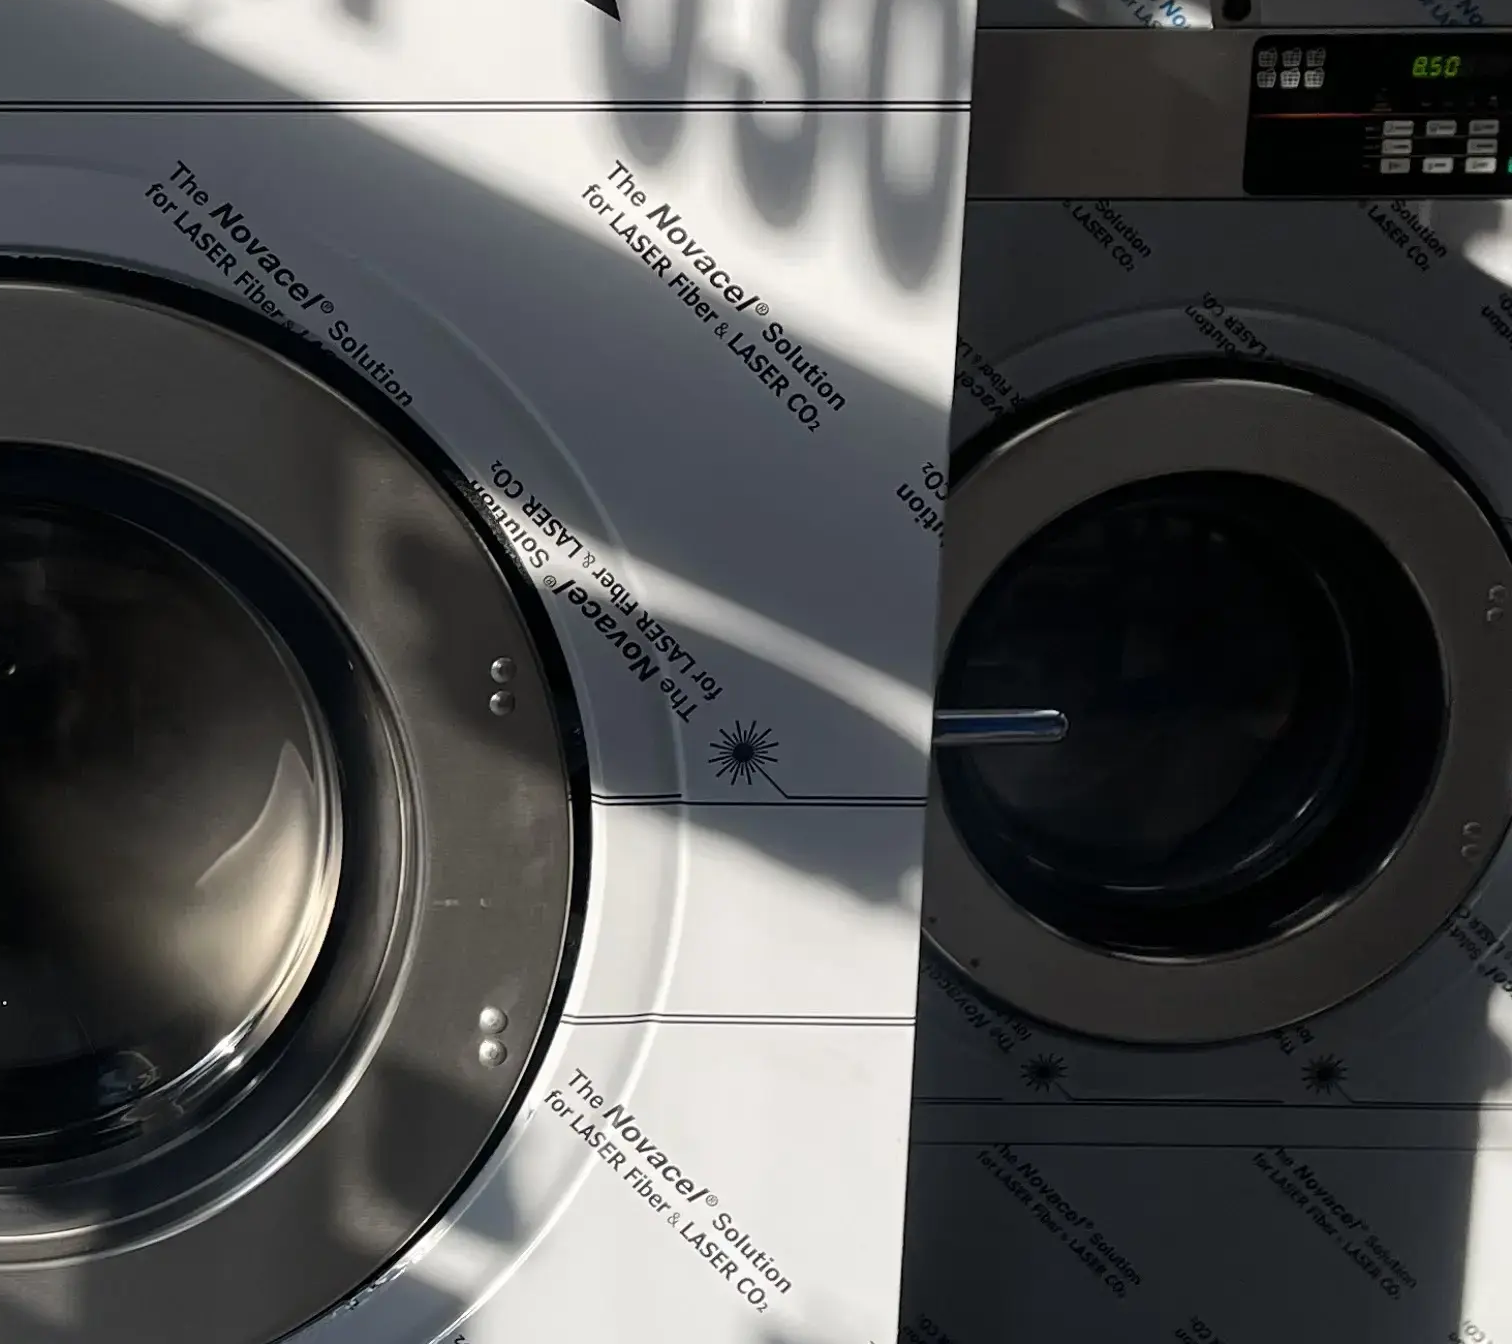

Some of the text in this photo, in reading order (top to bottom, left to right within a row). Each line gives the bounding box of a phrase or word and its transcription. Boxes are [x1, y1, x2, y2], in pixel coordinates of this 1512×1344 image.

[144, 182, 179, 214] for
[172, 209, 237, 277] LASER
[1071, 205, 1112, 247] LASER
[1368, 206, 1409, 247] LASER
[169, 160, 209, 207] The
[328, 320, 413, 407] Solution
[581, 183, 615, 216] for
[608, 211, 673, 278] LASER
[667, 271, 719, 323] Fiber
[713, 322, 729, 340] &
[727, 332, 790, 398] LASER
[607, 159, 647, 207] The
[762, 321, 846, 412] Solution
[522, 495, 584, 559] LASER
[581, 550, 596, 569] &
[591, 567, 639, 616] Fiber
[635, 610, 696, 675] LASER
[660, 677, 698, 723] The
[690, 671, 723, 701] for
[543, 1089, 574, 1118] for
[569, 1113, 627, 1172] LASER
[623, 1166, 672, 1213] Fiber
[666, 1211, 681, 1229] &
[679, 1221, 739, 1281] LASER
[568, 1068, 604, 1109] The
[712, 1212, 792, 1294] Solution
